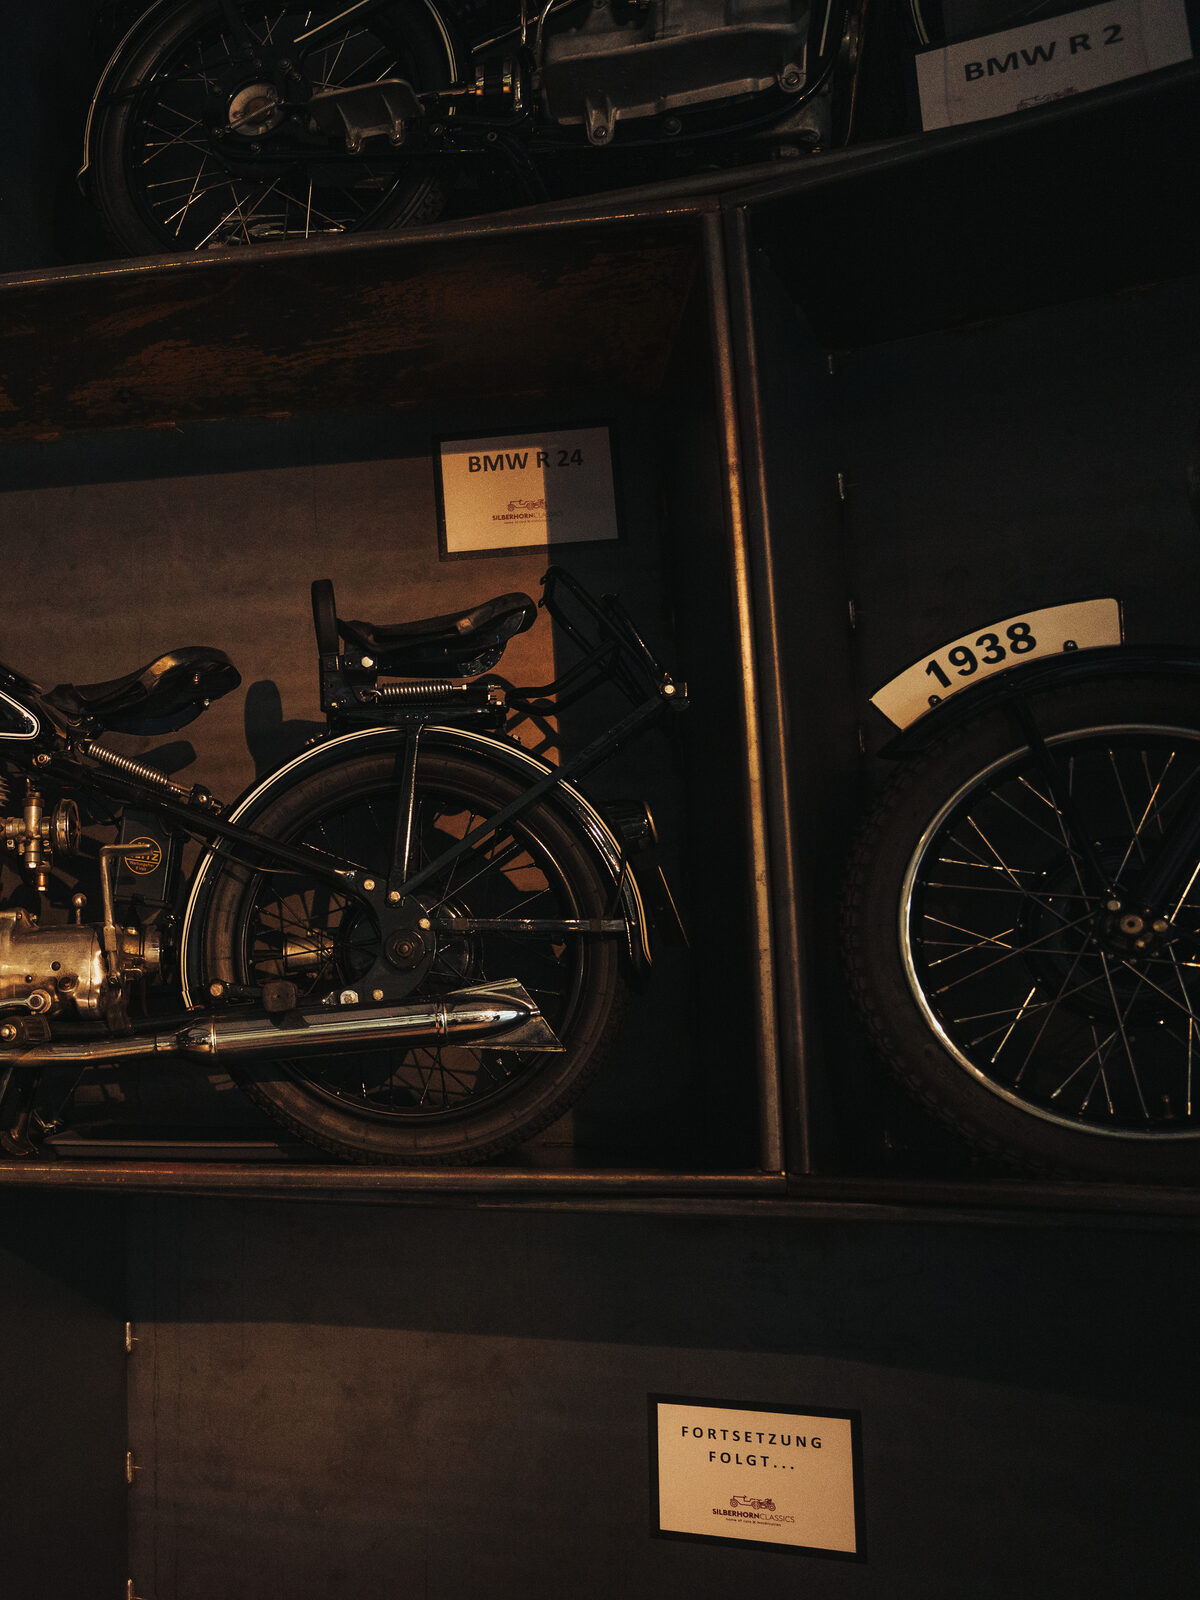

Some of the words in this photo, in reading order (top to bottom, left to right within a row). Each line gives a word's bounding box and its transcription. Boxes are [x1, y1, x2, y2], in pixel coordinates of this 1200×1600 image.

[965, 42, 1057, 82] BMW
[1069, 34, 1092, 55] R
[1103, 24, 1124, 46] 2
[468, 452, 529, 473] BMW
[536, 451, 550, 468] R
[557, 449, 583, 467] 24
[925, 622, 1037, 689] 1938
[681, 1426, 823, 1449] FORTSETZUNG
[709, 1451, 795, 1470] FOLGT...
[712, 1508, 795, 1523] SILBERHORNCLASSICS
